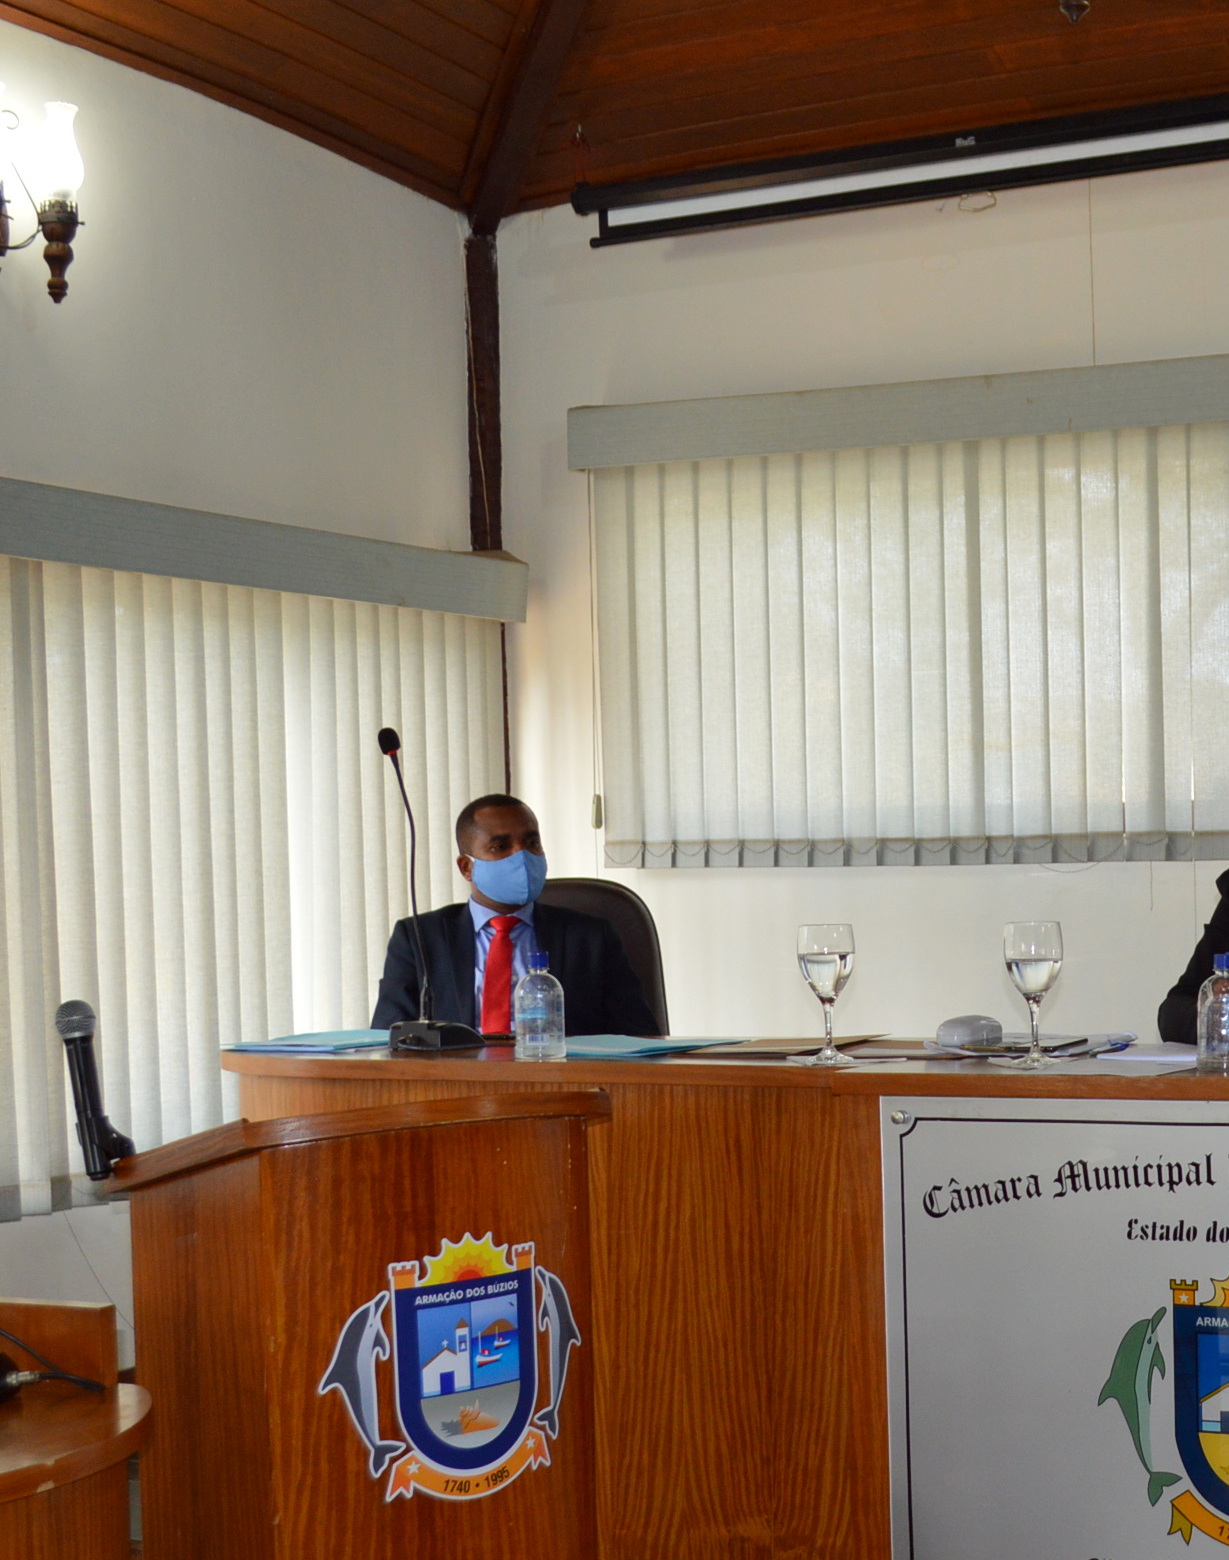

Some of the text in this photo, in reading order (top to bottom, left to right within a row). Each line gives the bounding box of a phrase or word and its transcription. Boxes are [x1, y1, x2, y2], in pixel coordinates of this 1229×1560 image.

[922, 1174, 1043, 1219] Câmara
[1053, 1153, 1217, 1199] Municipal
[1126, 1218, 1198, 1242] Estado
[414, 1280, 519, 1306] ARMAÇÃO DOS BÚZIOS
[444, 1465, 510, 1494] 1740 1995
